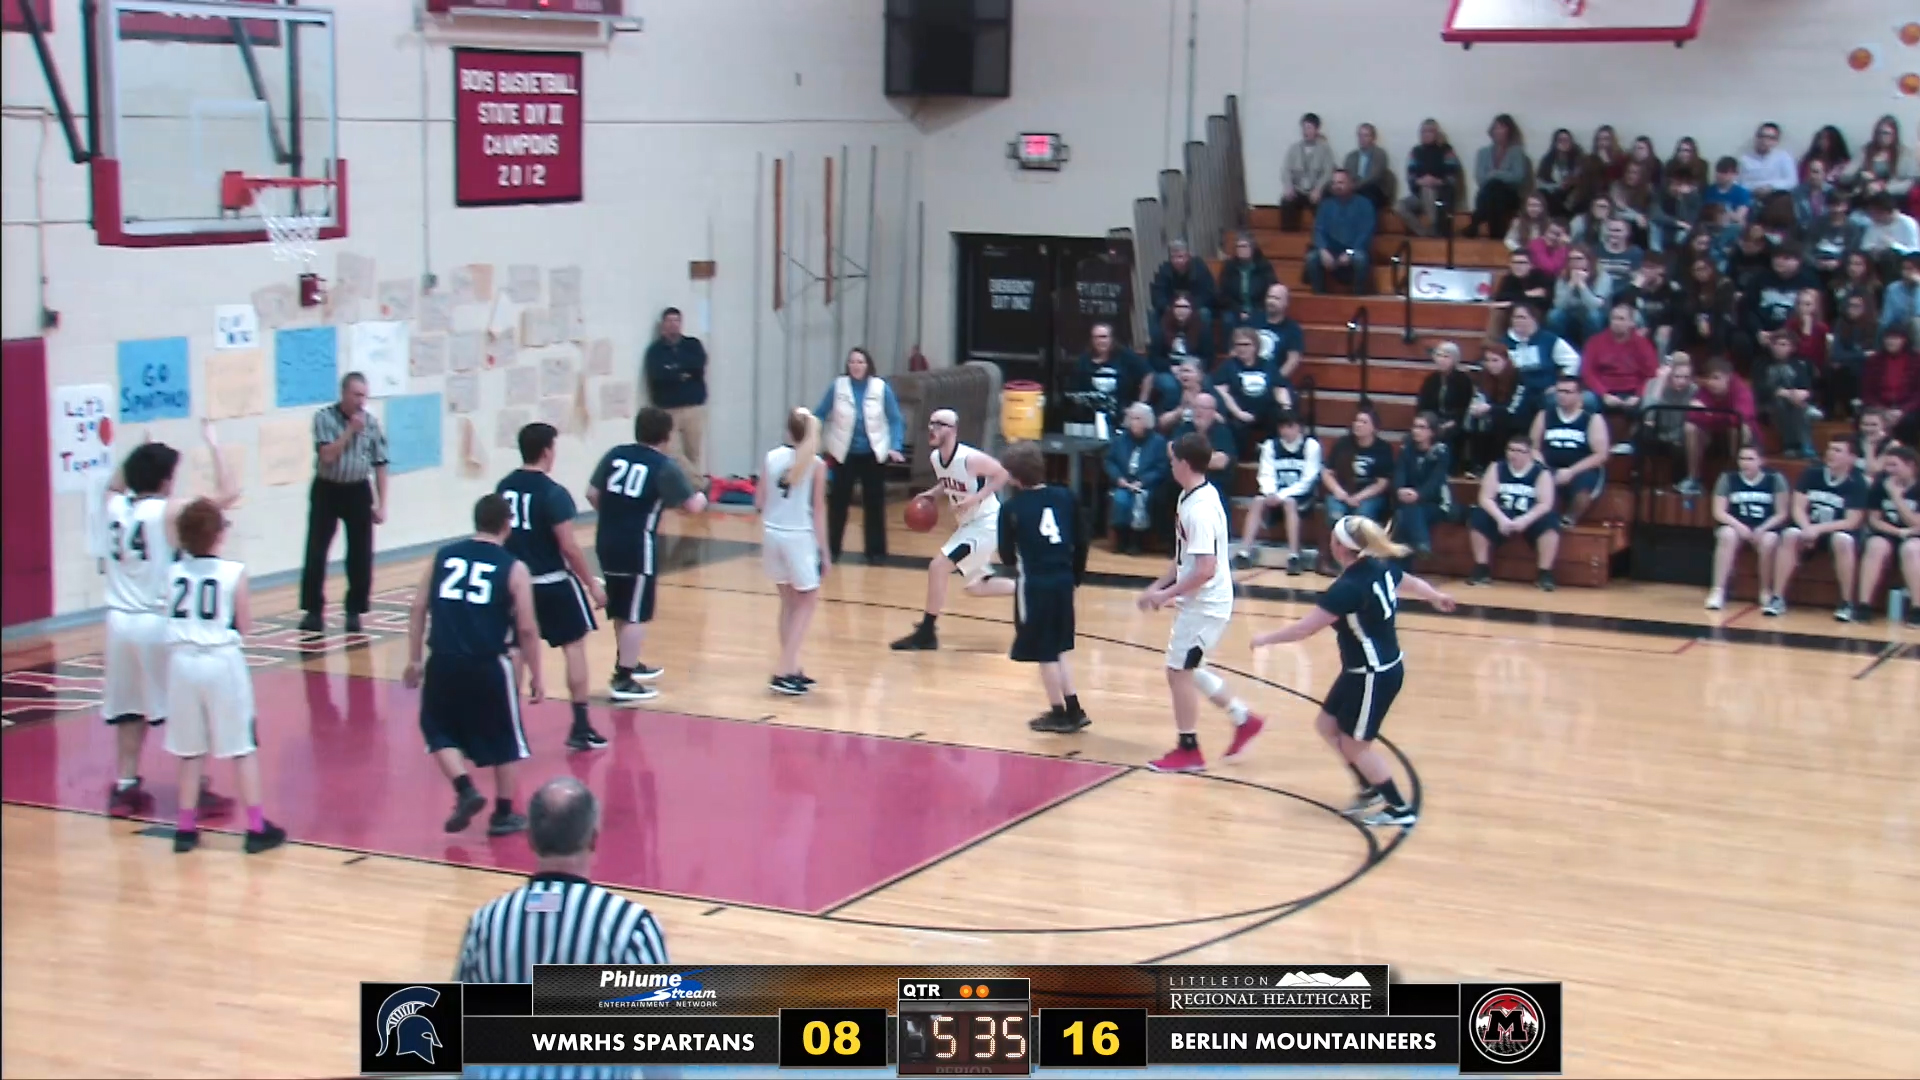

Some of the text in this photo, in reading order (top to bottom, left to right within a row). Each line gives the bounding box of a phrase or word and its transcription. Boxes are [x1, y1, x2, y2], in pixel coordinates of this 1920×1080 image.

[460, 68, 578, 95] BOYS BASKETBALL
[477, 102, 521, 124] STATE
[483, 133, 560, 156] CHAMPIONS
[498, 164, 546, 187] 2012
[607, 458, 648, 498] 20
[502, 490, 532, 530] 31
[1038, 507, 1062, 544] 4
[109, 520, 147, 561] 34
[171, 577, 218, 620] 20
[439, 557, 497, 605] 25
